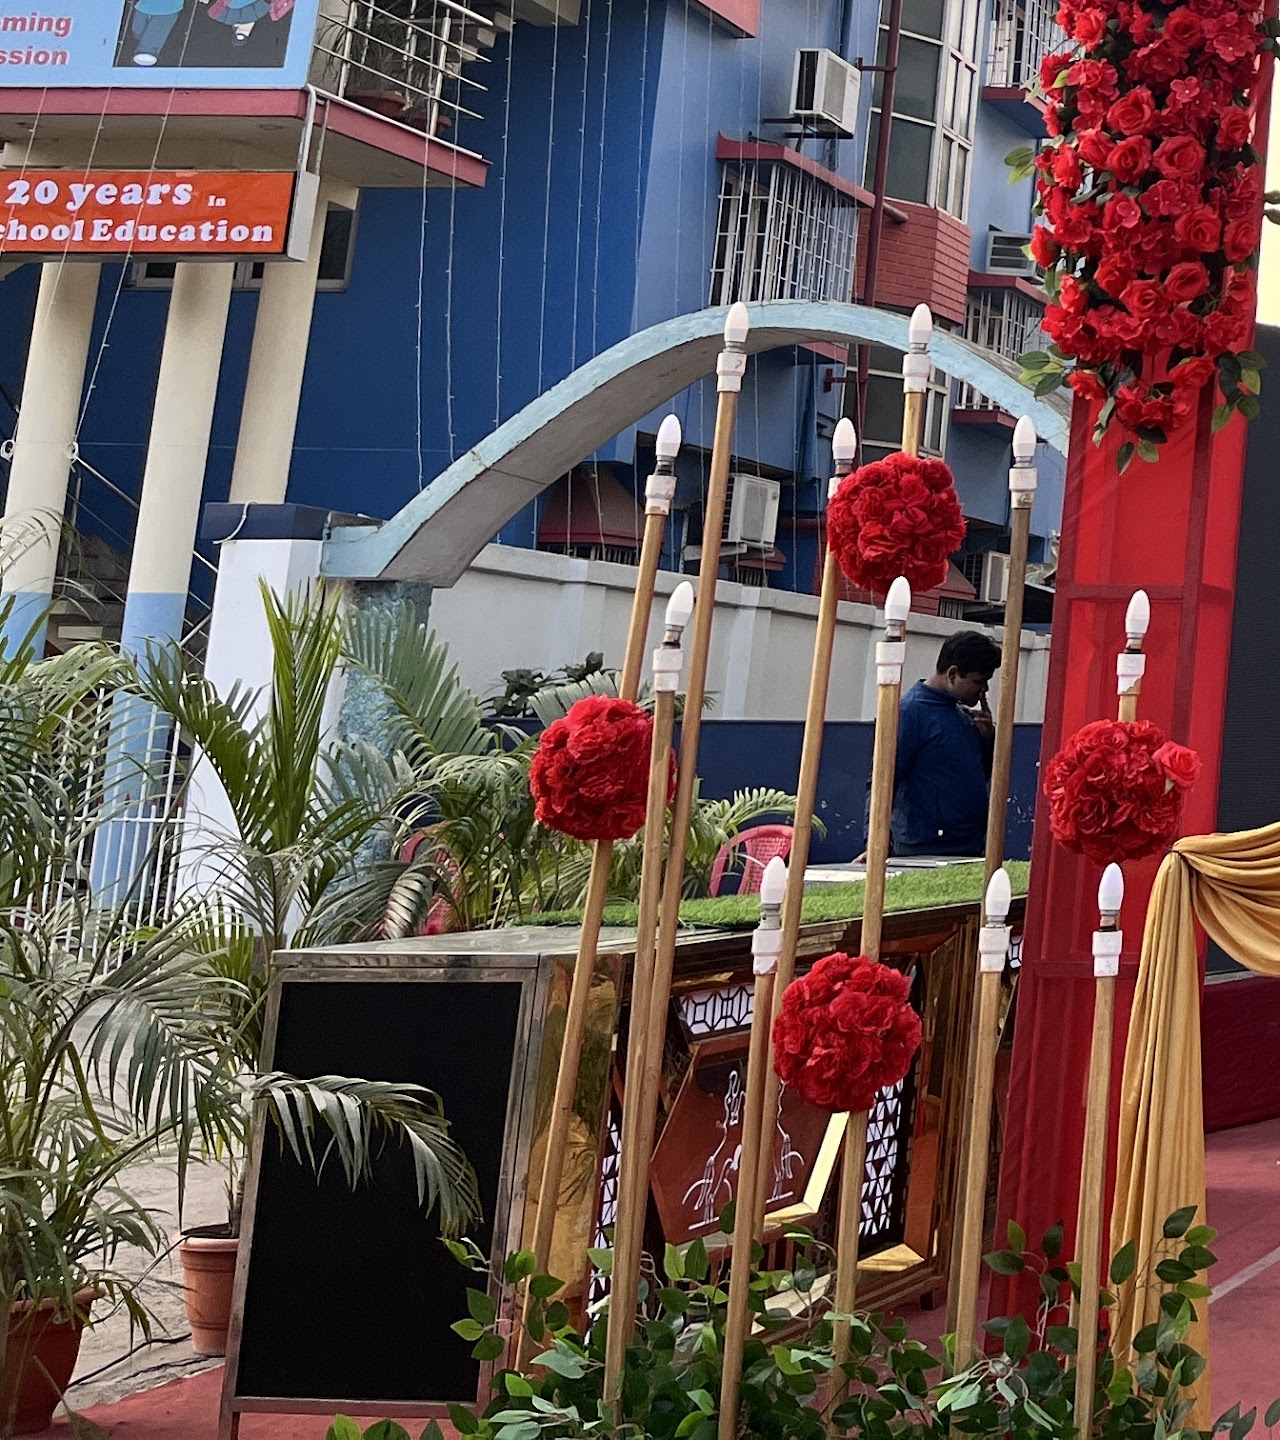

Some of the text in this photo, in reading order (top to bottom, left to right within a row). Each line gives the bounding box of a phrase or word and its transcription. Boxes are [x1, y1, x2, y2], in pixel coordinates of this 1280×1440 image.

[0, 12, 72, 37] ming
[5, 180, 226, 211] 20 years In
[89, 219, 273, 242] Education
